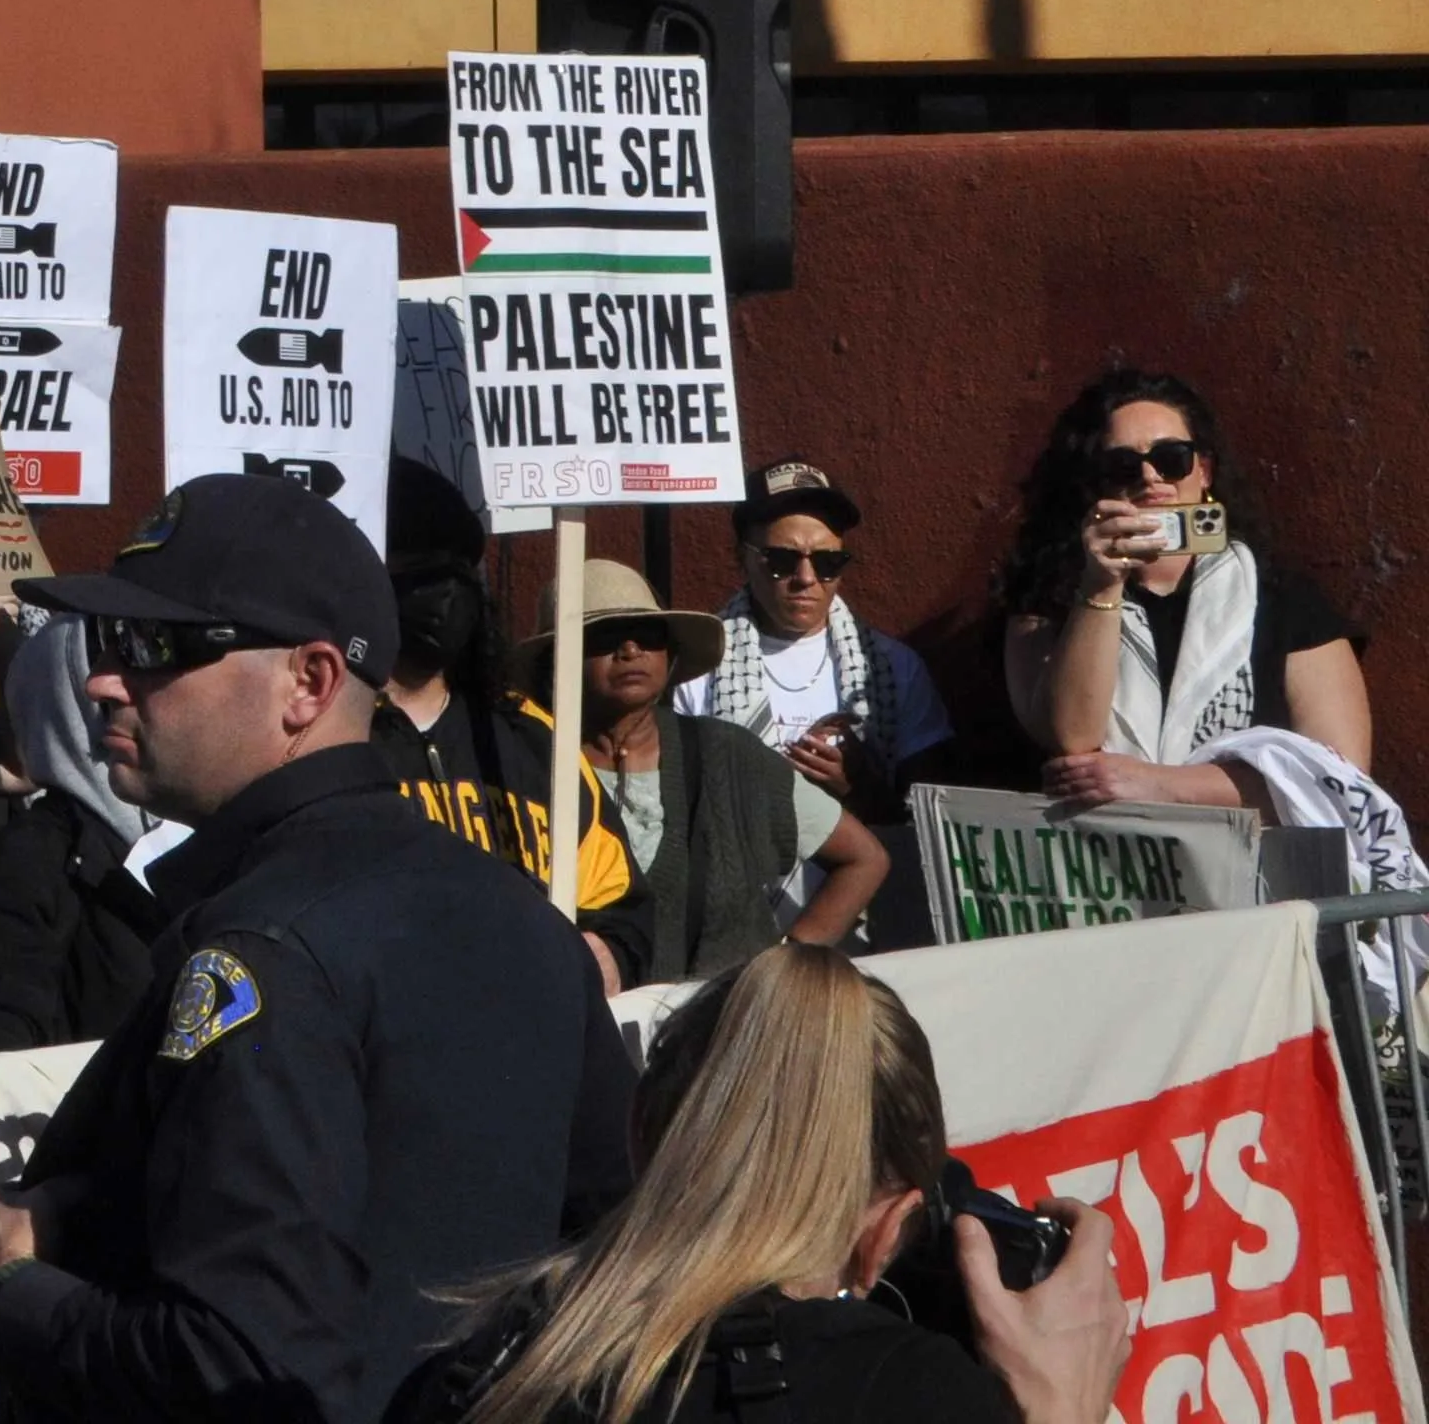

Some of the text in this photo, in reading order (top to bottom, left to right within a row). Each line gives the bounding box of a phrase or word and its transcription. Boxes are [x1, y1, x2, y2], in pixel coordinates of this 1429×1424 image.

[453, 61, 702, 116] FROM THE RIVER
[458, 124, 706, 199] TO THE SEA
[38, 263, 66, 300] TO
[260, 248, 331, 320] END
[469, 294, 722, 372] PALESTINE
[220, 375, 353, 429] U.S. AID TO
[476, 383, 731, 447] WILL BE FREE
[494, 459, 611, 499] FRSO
[942, 821, 1186, 903] HEALTHCARE
